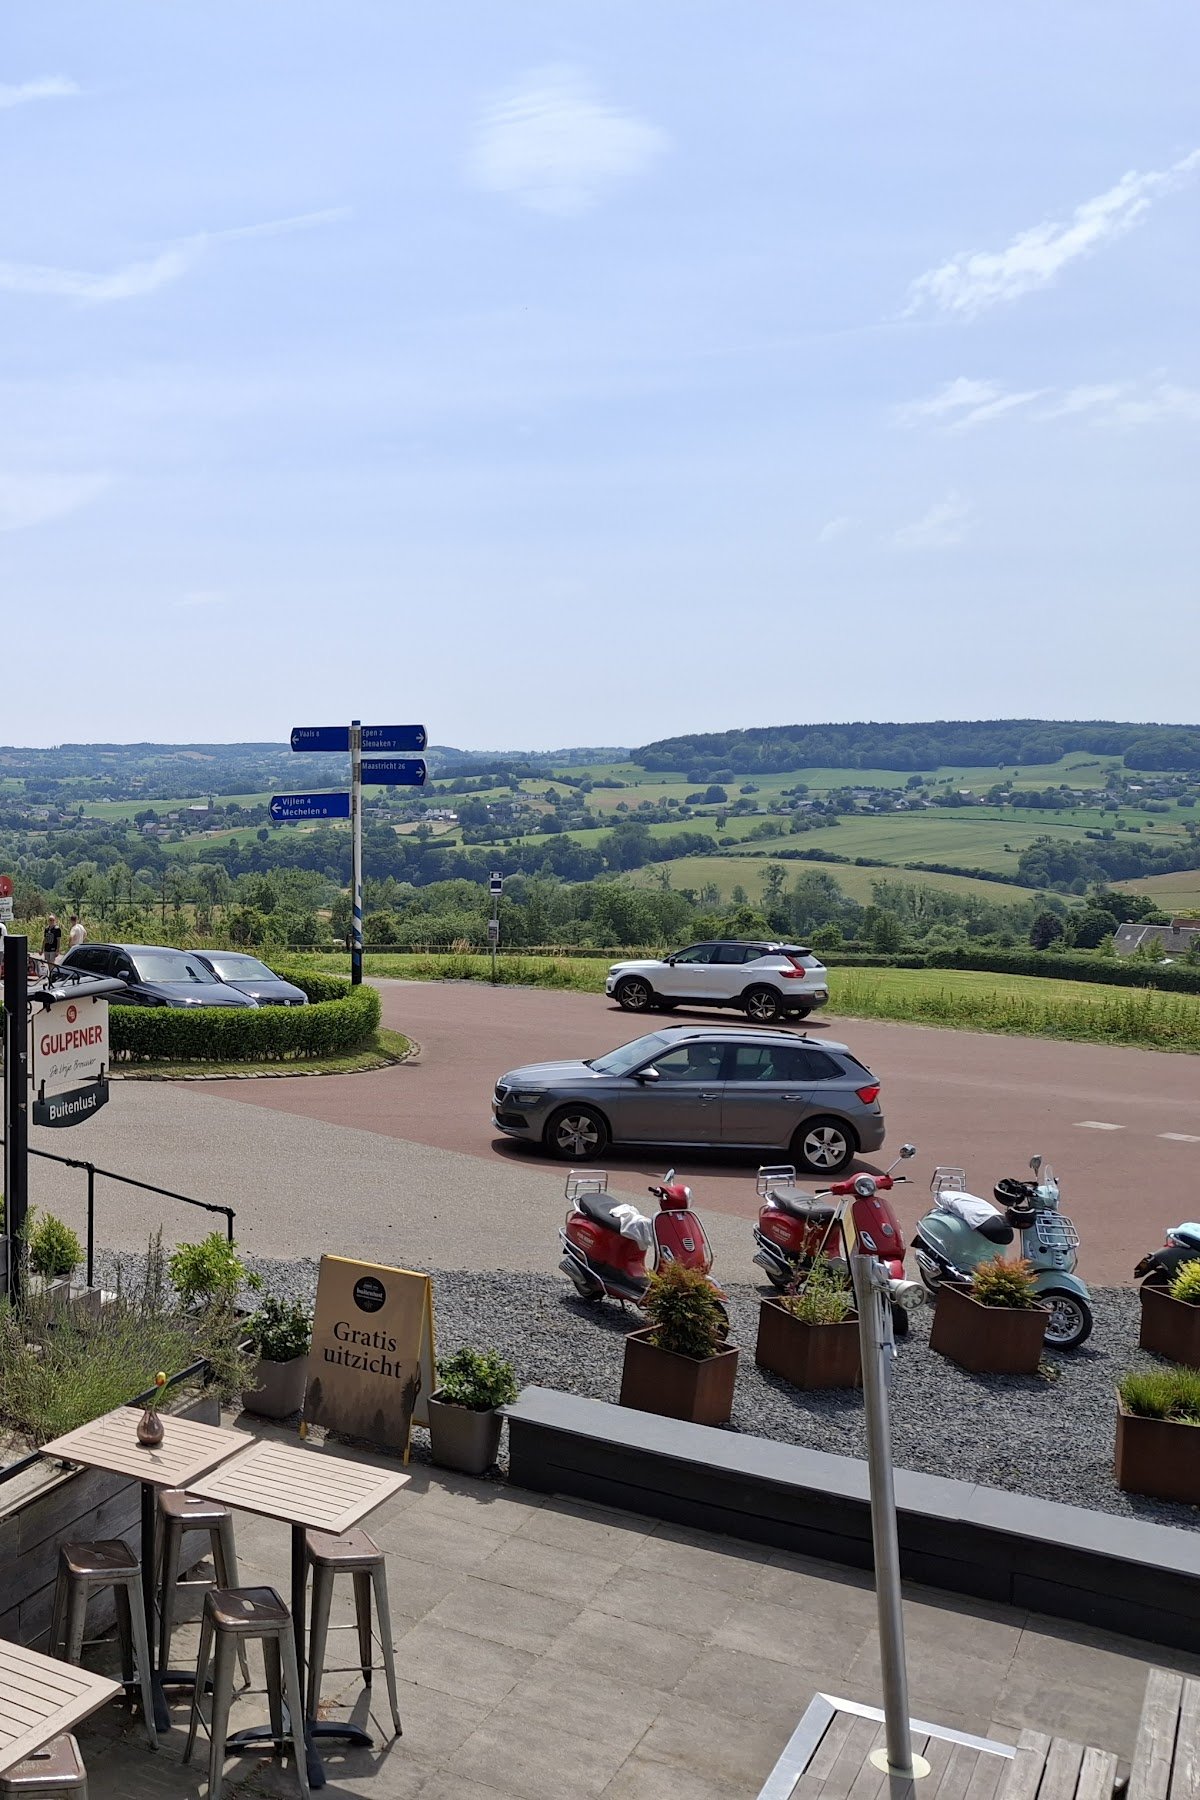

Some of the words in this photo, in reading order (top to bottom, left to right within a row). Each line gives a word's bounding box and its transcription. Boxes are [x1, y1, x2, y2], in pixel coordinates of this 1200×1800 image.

[362, 729, 378, 738] Epen
[362, 762, 397, 770] Maastricht
[282, 797, 305, 807] Vijlen
[282, 808, 321, 816] Mechelen
[40, 1025, 103, 1056] GULPENER
[49, 1093, 96, 1120] Buitenlust
[333, 1321, 397, 1352] Gratis
[324, 1346, 402, 1378] uitzicht
